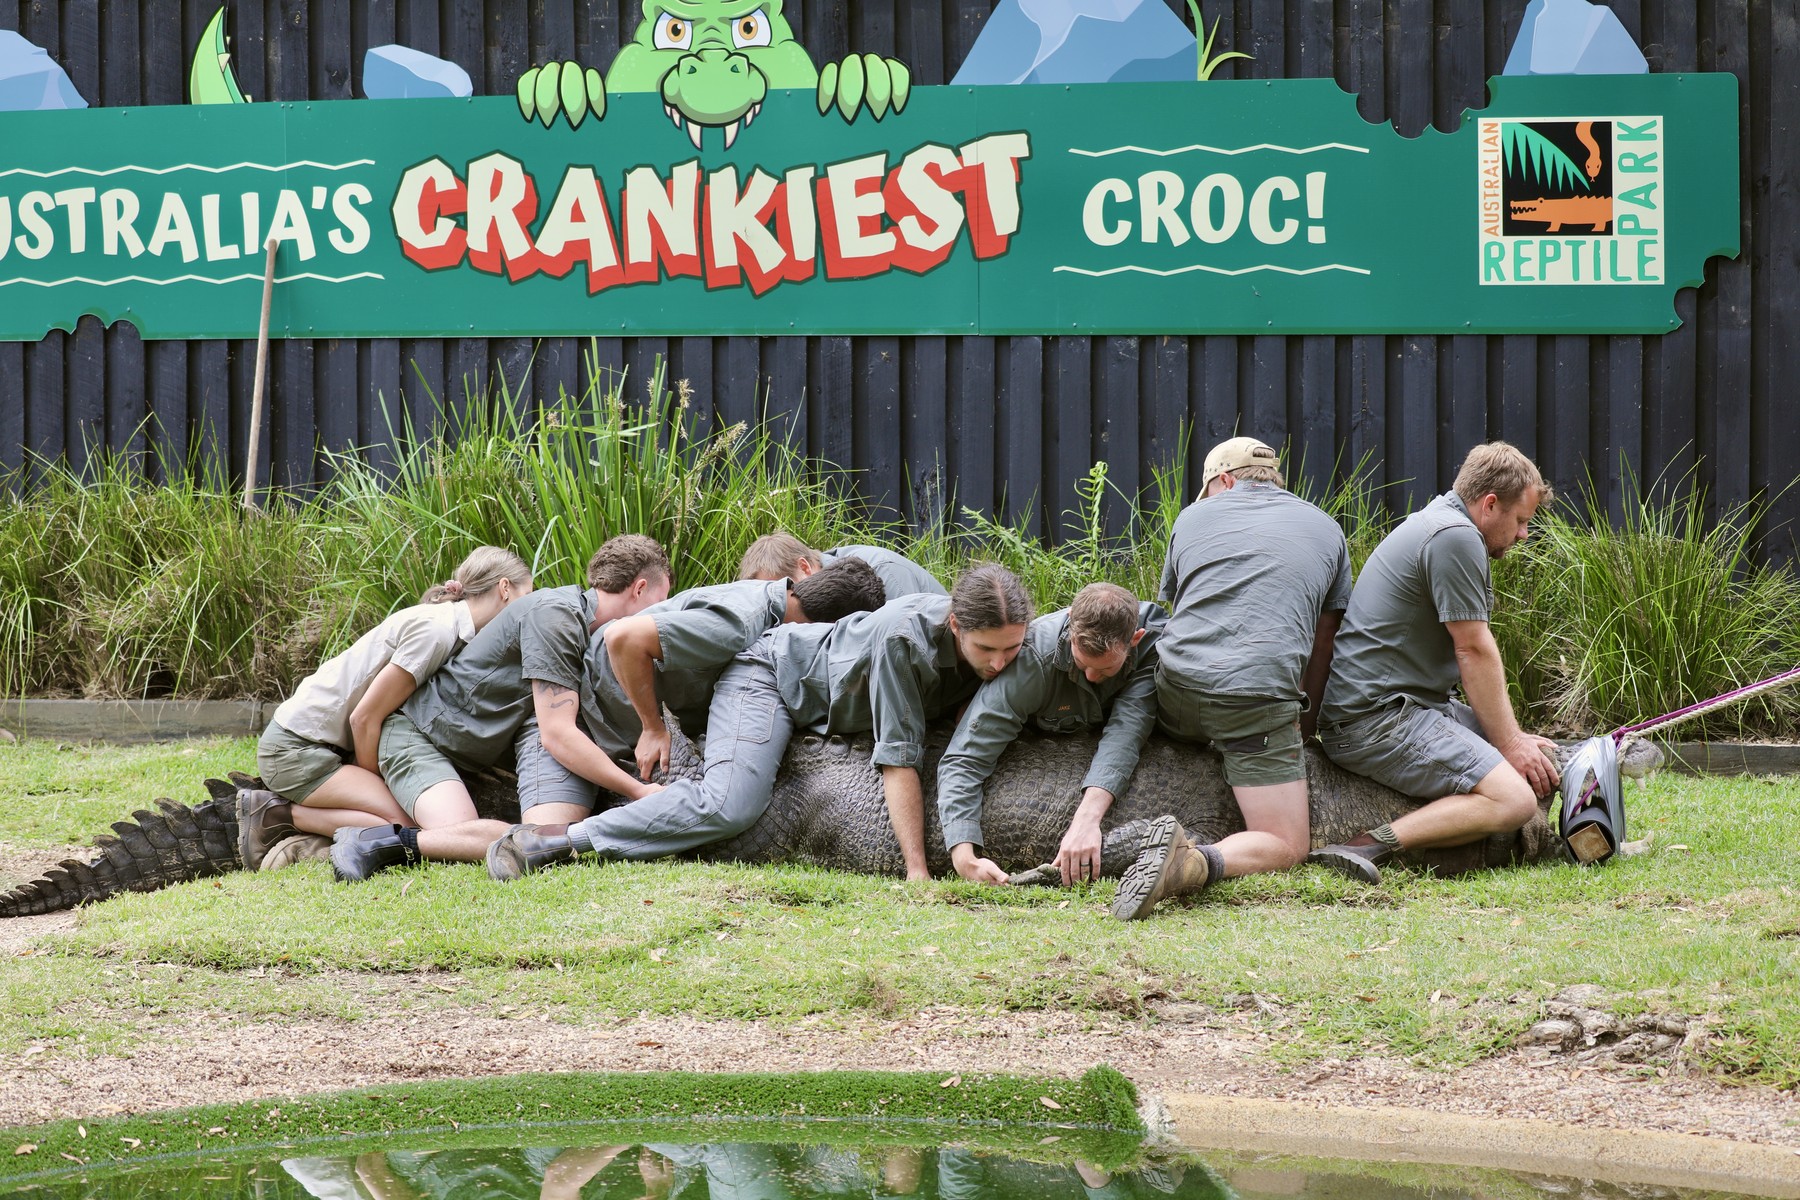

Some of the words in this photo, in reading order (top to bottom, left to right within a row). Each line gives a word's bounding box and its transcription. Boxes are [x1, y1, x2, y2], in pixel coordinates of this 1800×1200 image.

[393, 131, 1032, 294] CRANKIEST
[1082, 170, 1327, 247] CROC!
[1483, 122, 1500, 237] AUSTRALIAN
[1616, 119, 1659, 236] PARK
[1483, 239, 1660, 282] REPTILE
